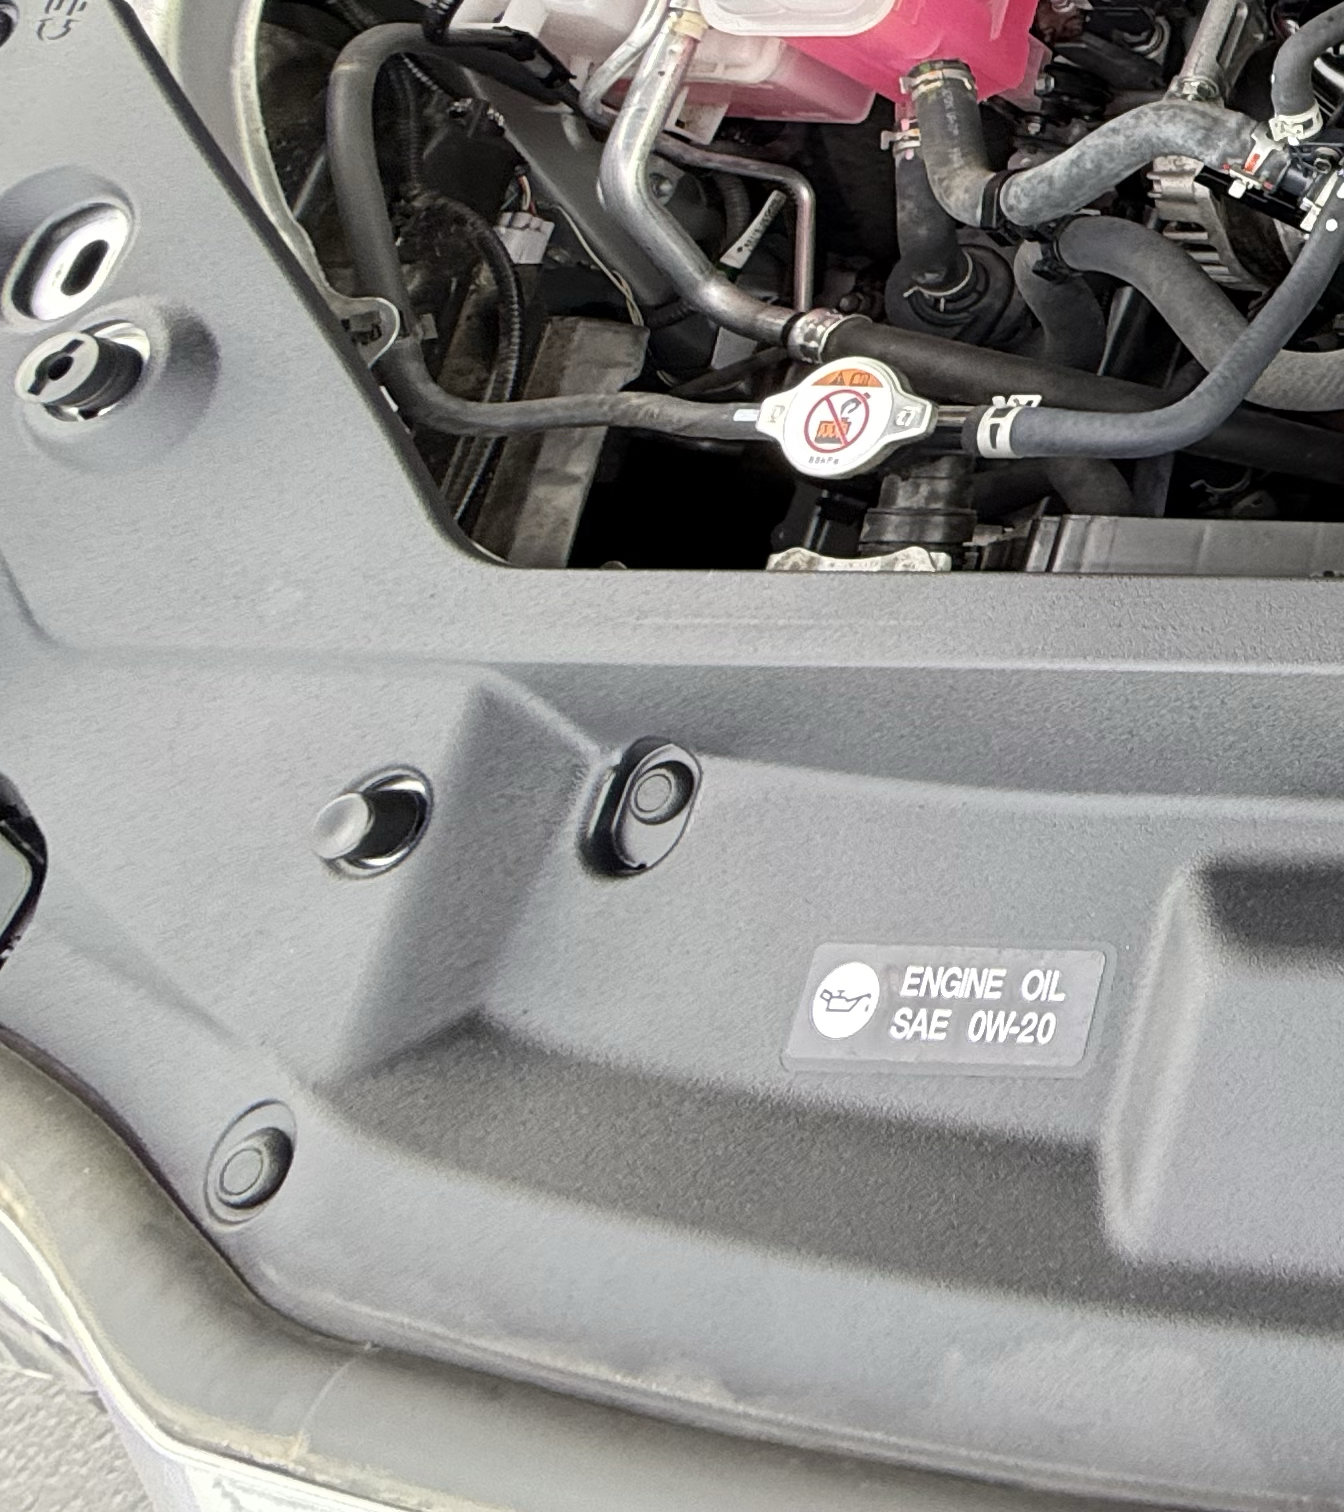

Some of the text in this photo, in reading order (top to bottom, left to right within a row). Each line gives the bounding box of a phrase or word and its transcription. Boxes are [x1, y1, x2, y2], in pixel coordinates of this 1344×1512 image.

[899, 965, 1067, 1002] ENGINE OIL
[889, 1007, 1058, 1046] SAE 0W-20
